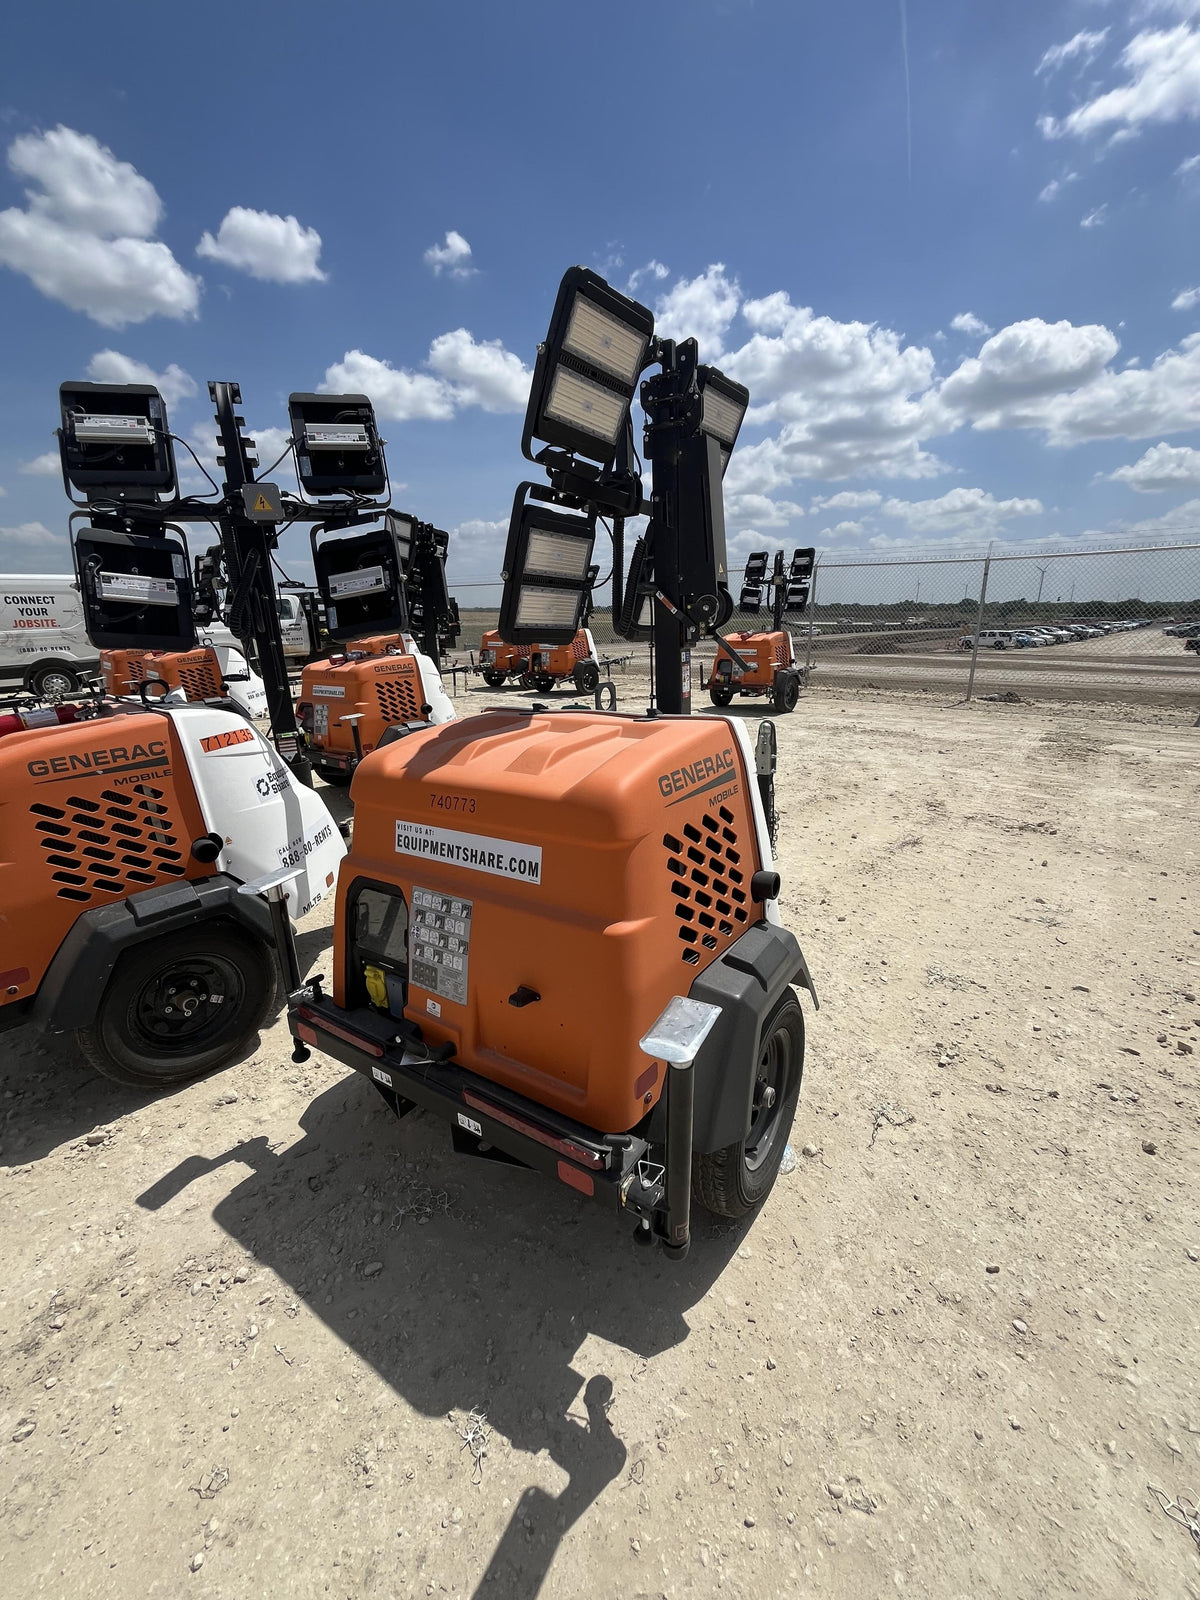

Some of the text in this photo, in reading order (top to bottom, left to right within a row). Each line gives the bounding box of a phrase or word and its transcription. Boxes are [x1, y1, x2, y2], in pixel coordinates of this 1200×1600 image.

[4, 596, 55, 605] CONNECT
[17, 608, 49, 616] YOUR
[13, 619, 61, 628] JOBSITE.
[374, 662, 414, 673] GENERAC
[202, 729, 254, 752] 712135
[27, 741, 167, 776] GENERAC
[114, 769, 173, 786] MOBILE
[658, 748, 735, 797] GENERAC
[430, 794, 477, 813] 740773
[708, 785, 739, 807] MOBILE
[397, 824, 412, 832] VISIT
[278, 843, 291, 855] CALL
[282, 824, 332, 868] 888-80-RENTS
[397, 834, 539, 878] EQUIPMENTSHARE.COM
[302, 893, 322, 914] MLTS
